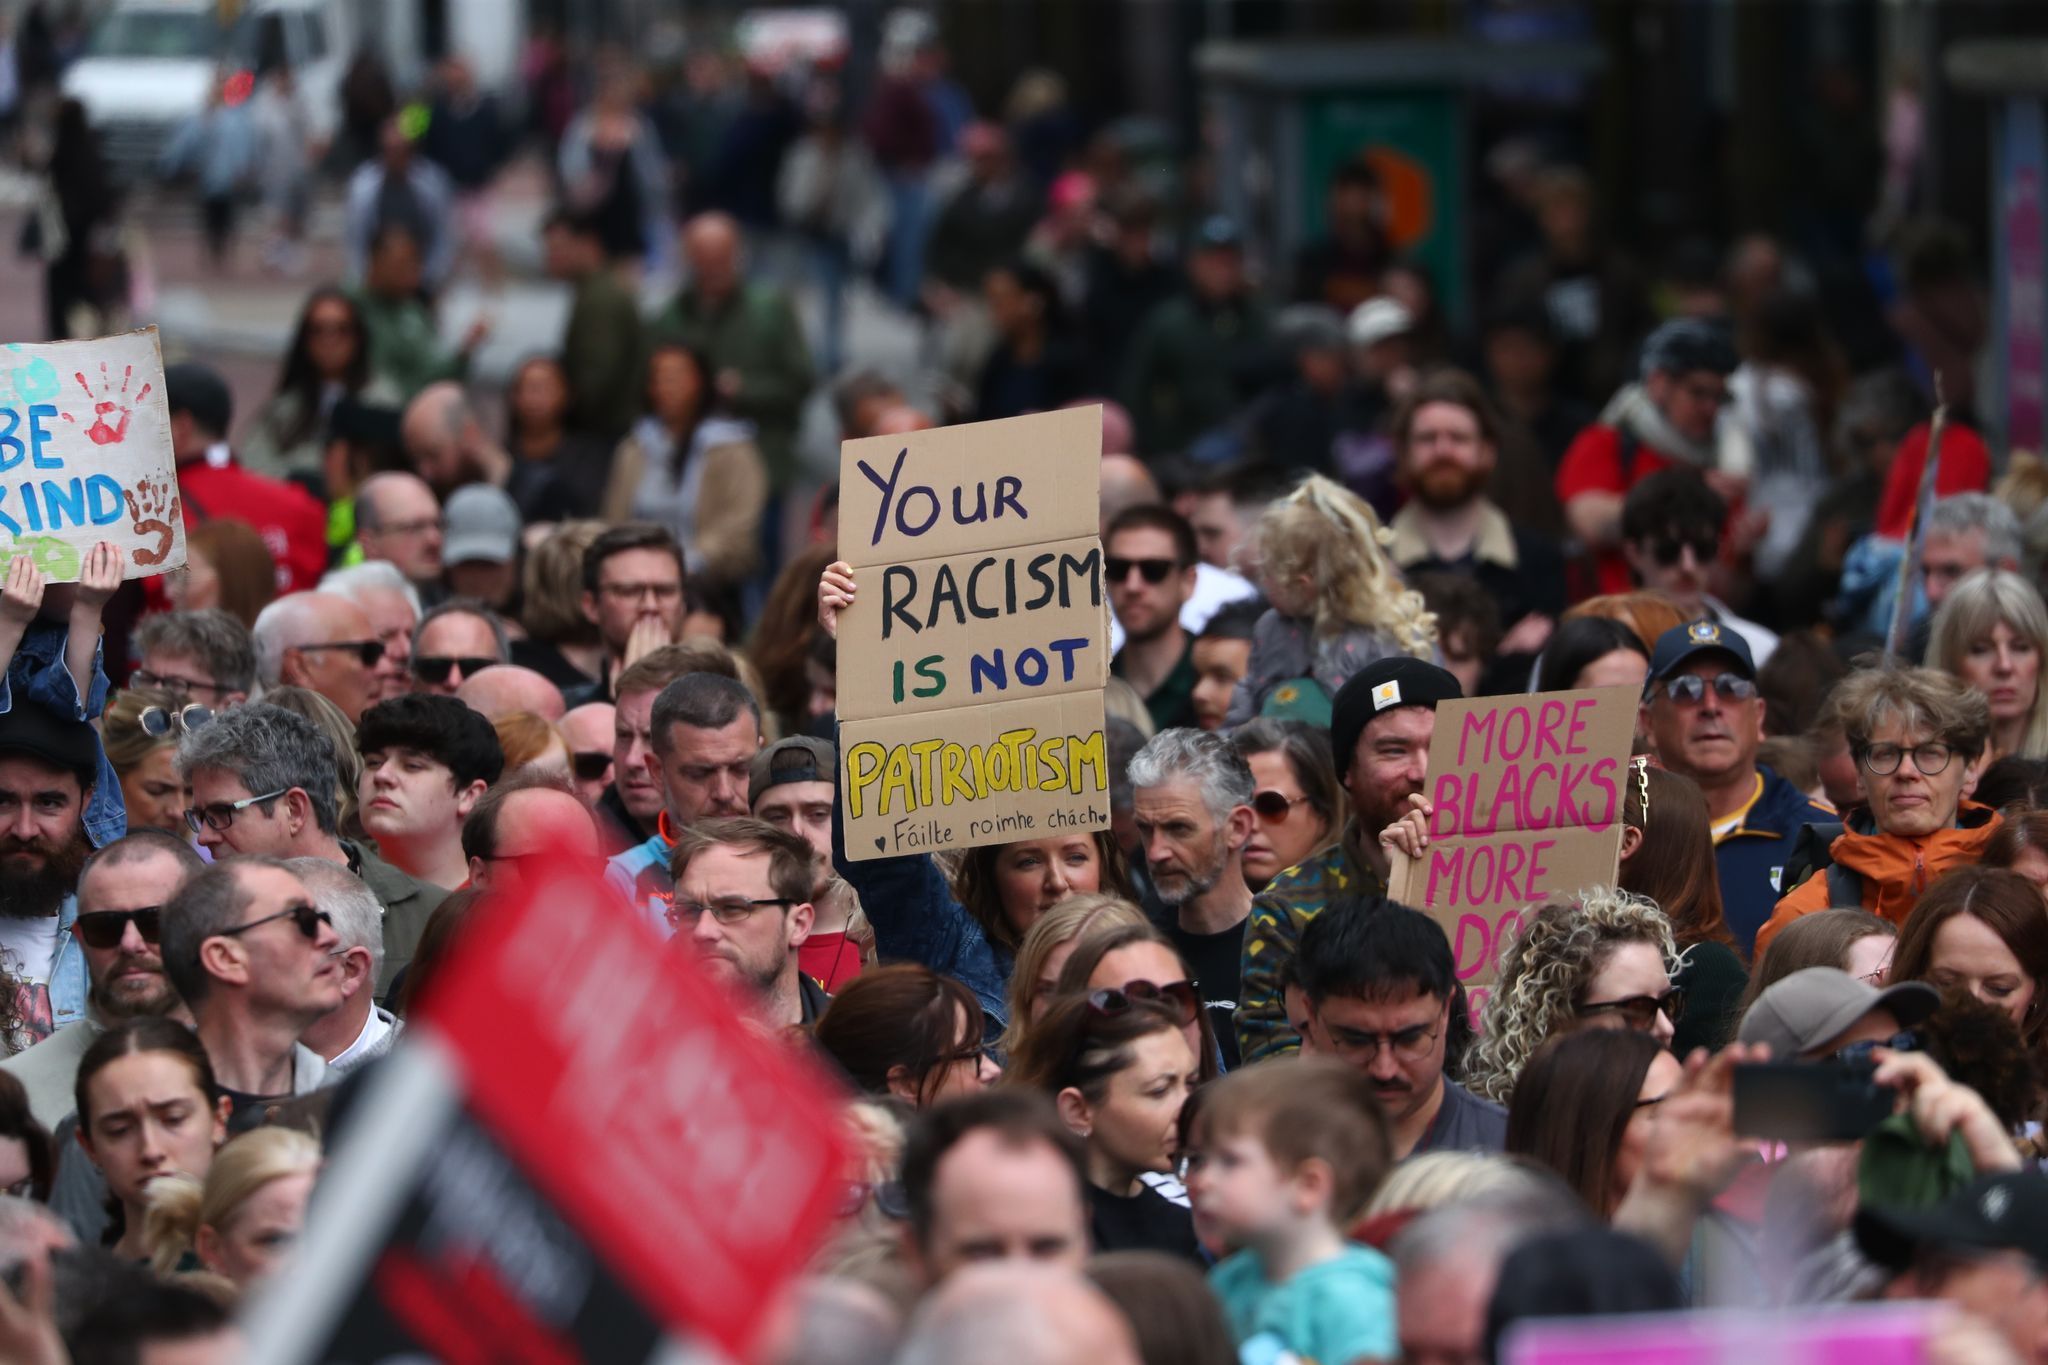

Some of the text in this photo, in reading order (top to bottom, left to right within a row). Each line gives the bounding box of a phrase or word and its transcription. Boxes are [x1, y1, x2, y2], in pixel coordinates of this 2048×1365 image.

[881, 548, 1101, 641] RACISM
[892, 637, 1090, 704] IS NOT
[1457, 699, 1597, 766] MORE
[847, 727, 1107, 819] PATRIOTISM
[1430, 757, 1618, 841] BLACKS
[893, 817, 953, 851] Fáilte
[970, 810, 1036, 838] roimhe
[1425, 840, 1557, 907] MORE
